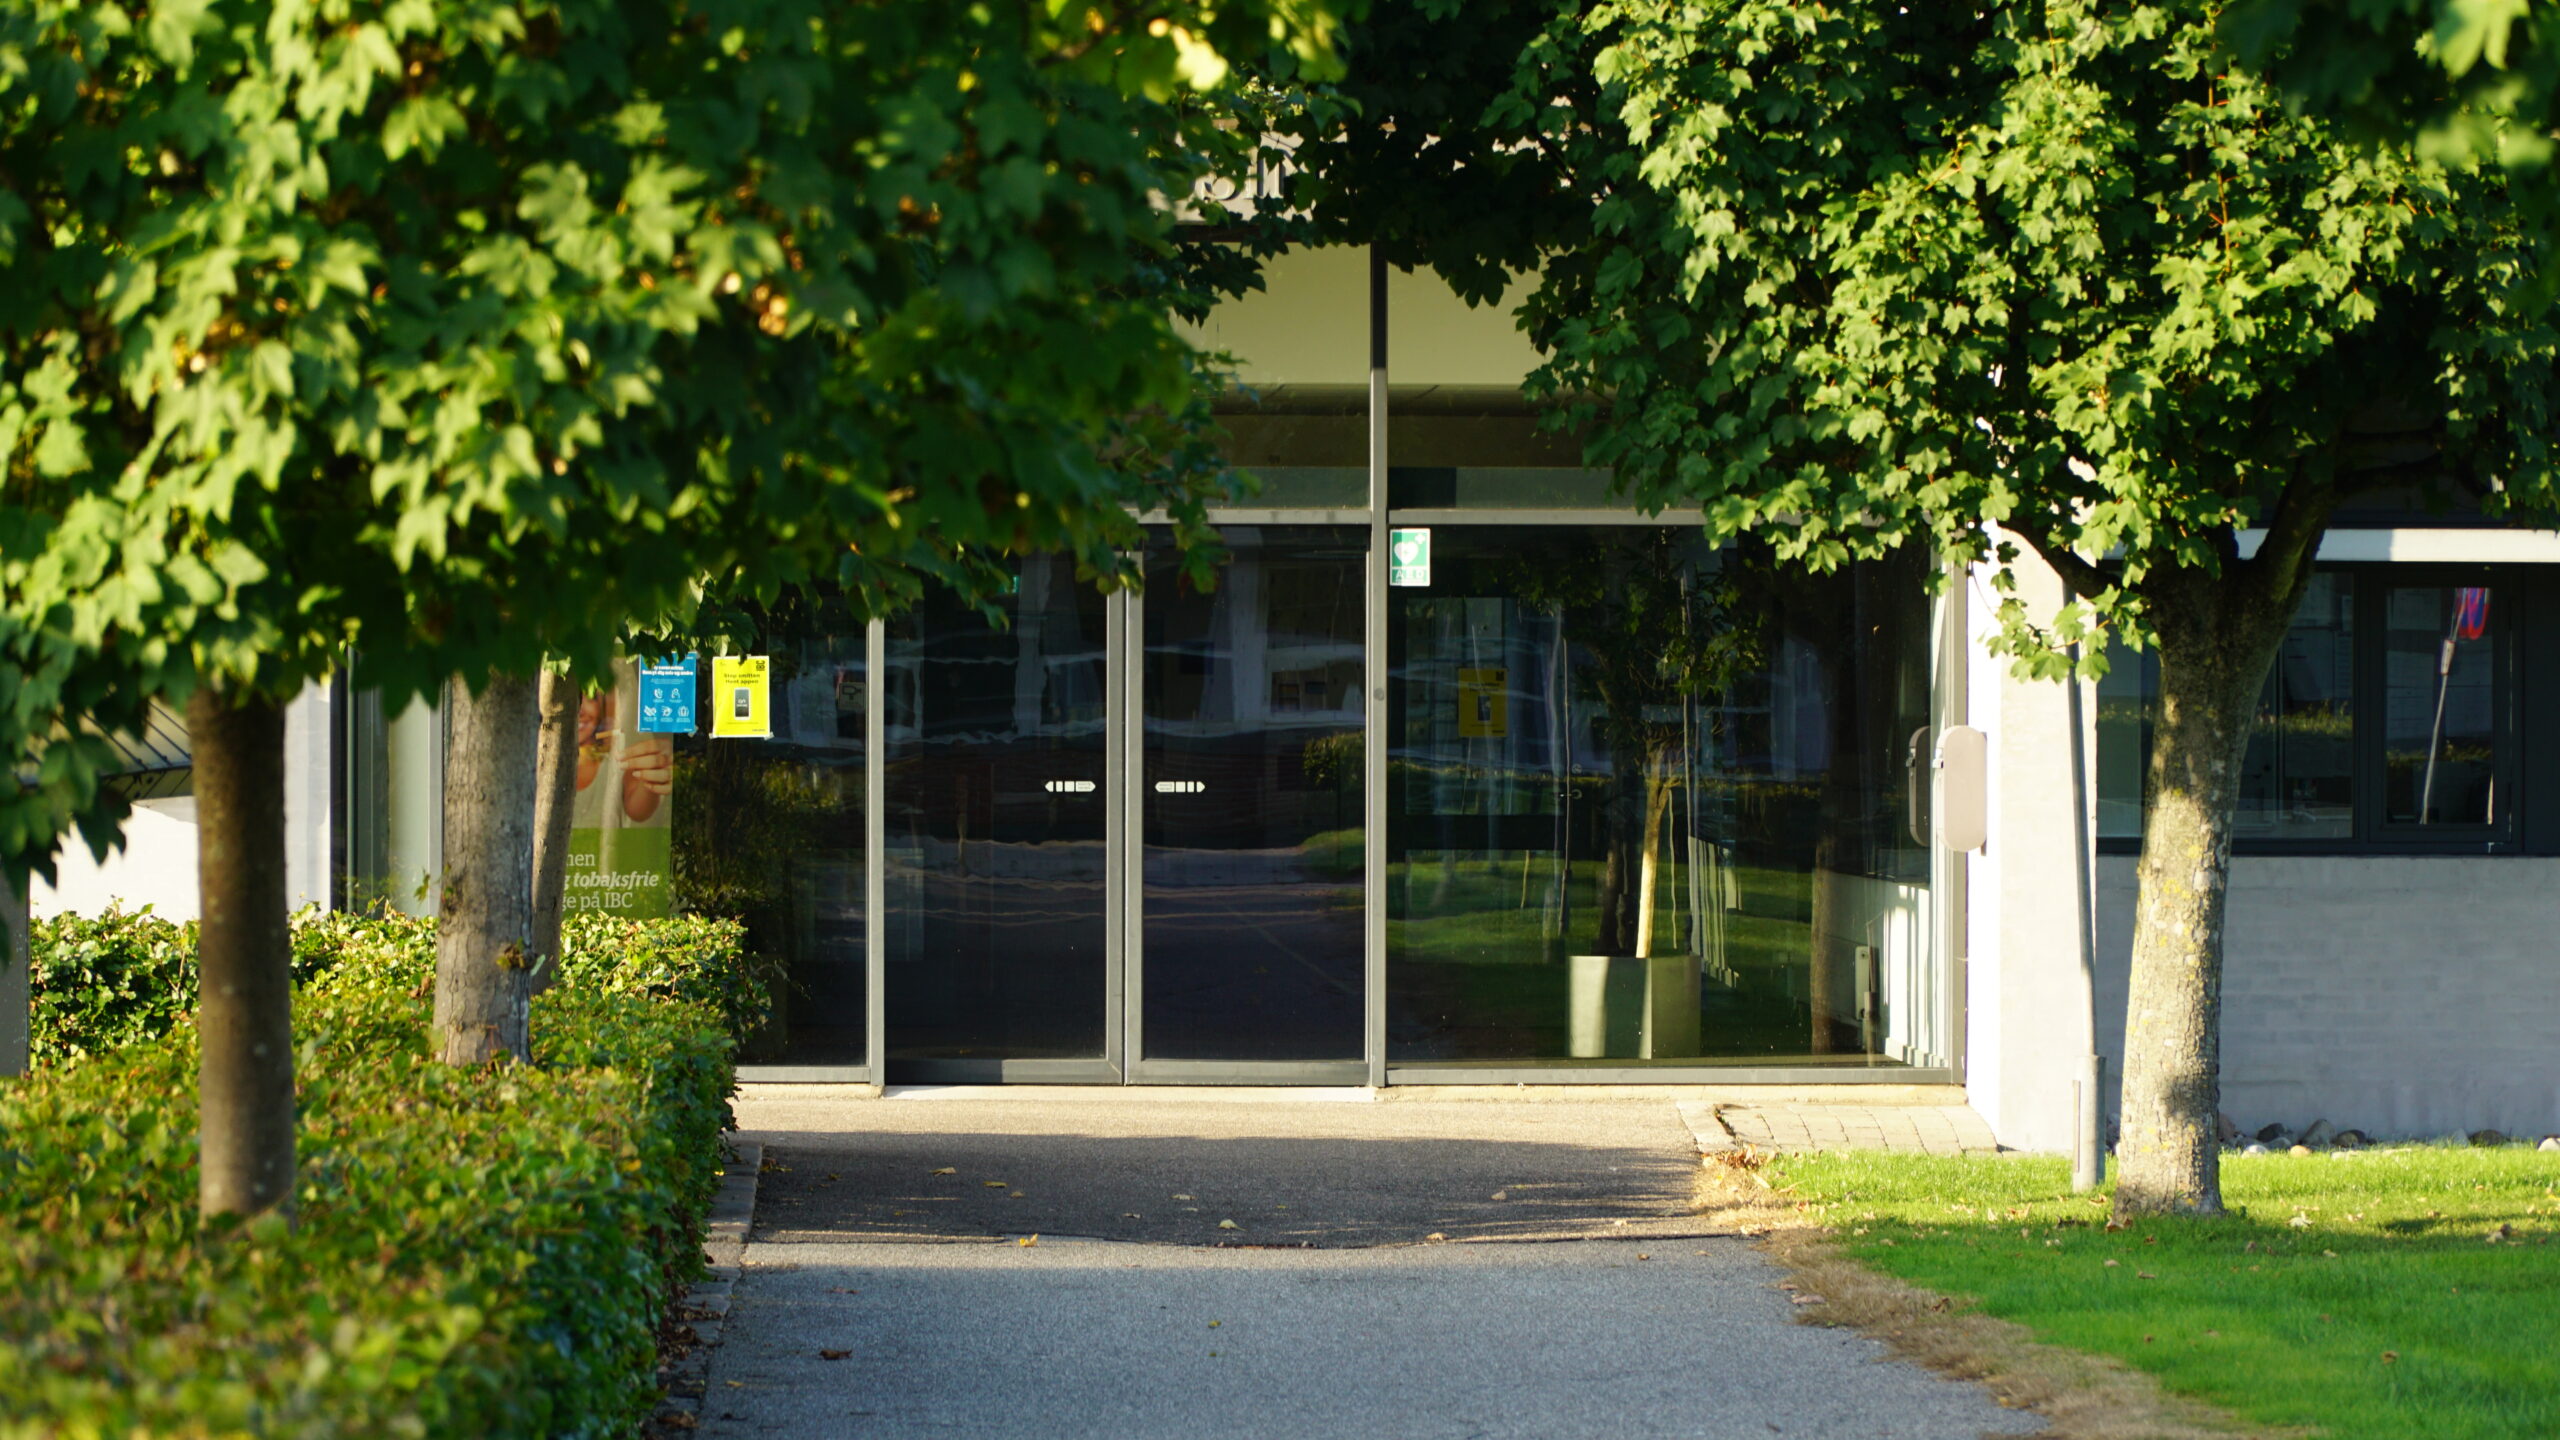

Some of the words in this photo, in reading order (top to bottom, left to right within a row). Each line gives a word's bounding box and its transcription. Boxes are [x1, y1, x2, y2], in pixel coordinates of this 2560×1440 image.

[573, 871, 659, 890] tobaksfrie
[580, 891, 601, 911] på
[604, 892, 633, 908] IBC
